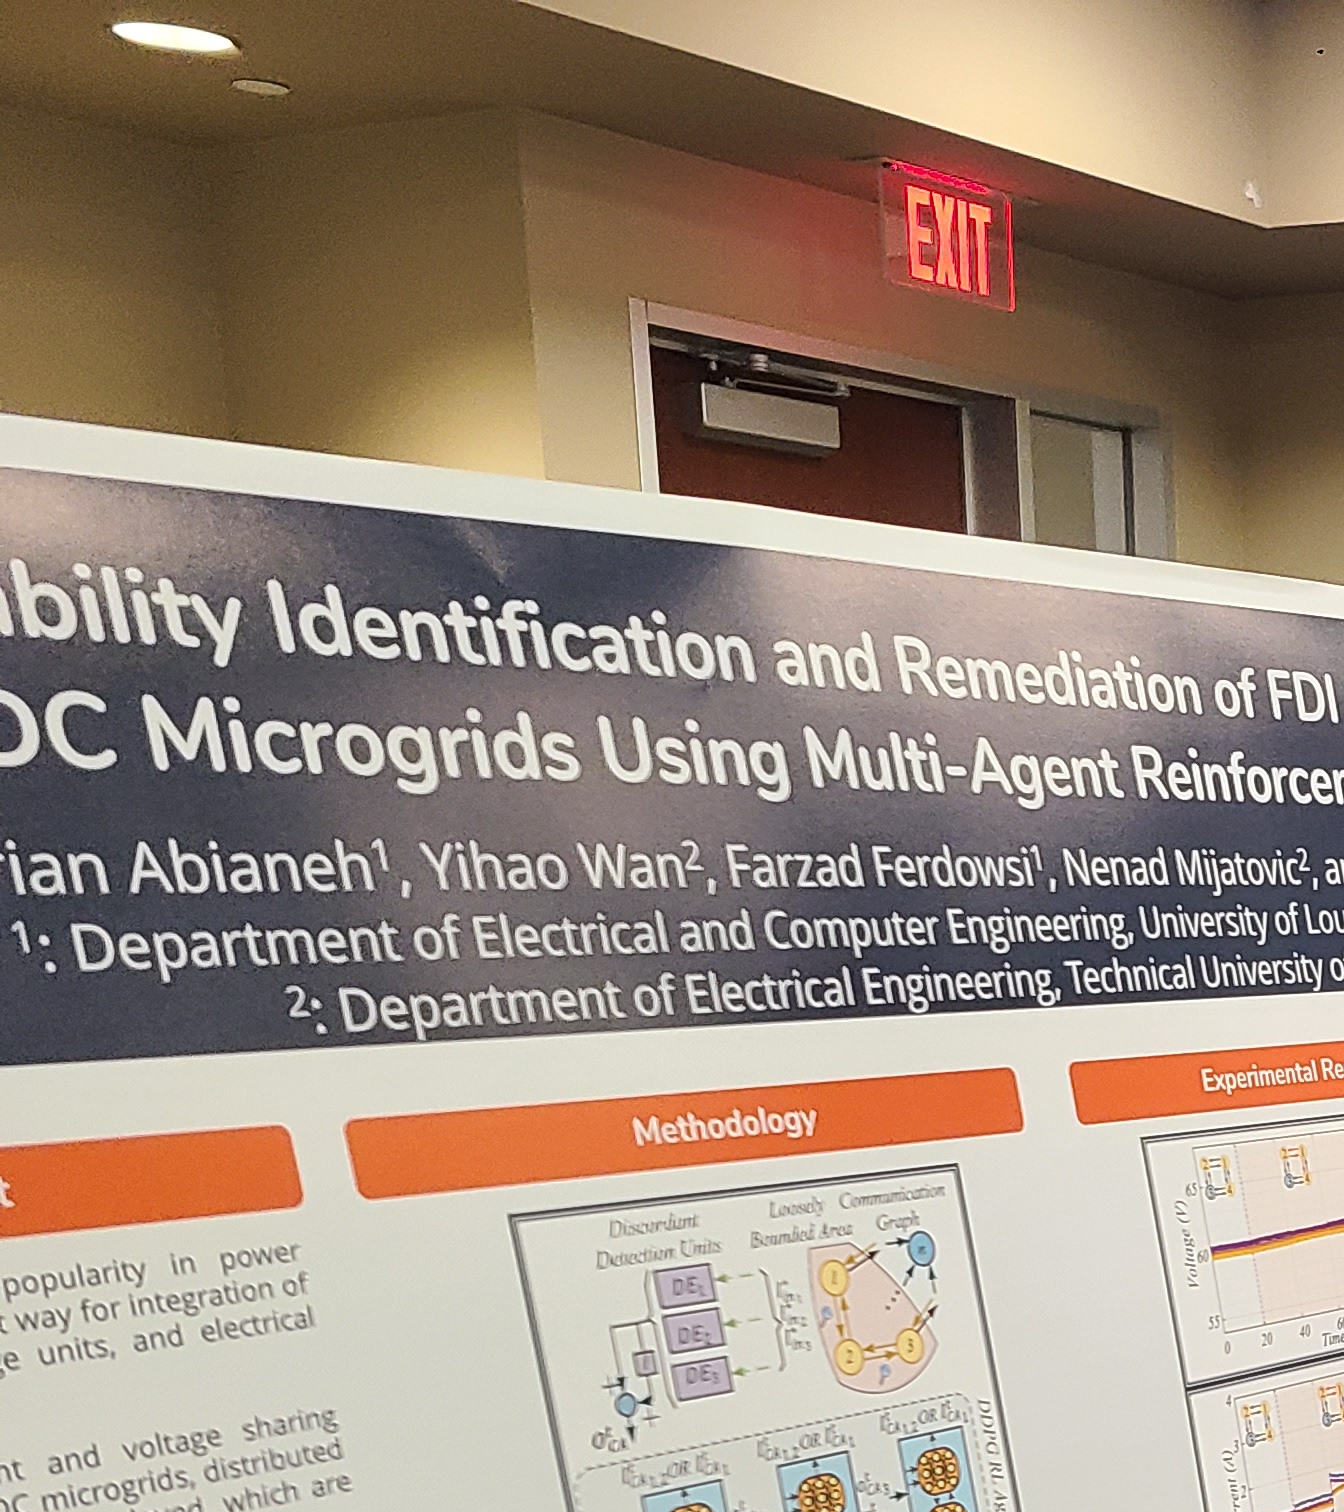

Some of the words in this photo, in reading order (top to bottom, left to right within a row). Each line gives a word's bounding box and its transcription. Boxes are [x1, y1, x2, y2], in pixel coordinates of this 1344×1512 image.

[904, 183, 992, 297] EXIT
[0, 558, 240, 667] bility
[266, 578, 757, 685] Identification
[773, 629, 882, 692] and
[896, 635, 1202, 717] Remediation
[1215, 668, 1257, 717] of
[1267, 669, 1341, 726] FDI
[141, 692, 582, 794] Microgrids
[598, 715, 793, 802] Using
[807, 725, 1123, 810] Multi-Agent
[419, 839, 568, 892] Yihao
[724, 842, 866, 889] Farzad
[1063, 847, 1169, 886] Nenad
[69, 917, 404, 984] Department
[413, 912, 463, 961] of
[474, 908, 669, 961] Electrical
[678, 908, 757, 955] and
[763, 908, 940, 962] Computer
[948, 904, 1136, 954] Engineering,
[1139, 901, 1269, 949] University
[1273, 901, 1300, 938] of
[339, 977, 624, 1040] Department
[633, 973, 676, 1020] of
[684, 968, 855, 1017] Electrical
[861, 964, 1064, 1014] Engineering,
[1065, 953, 1196, 997] Technical
[1199, 949, 1324, 994] University
[1201, 1065, 1317, 1095] Experimental
[632, 1108, 817, 1147] Methodology
[3, 1258, 147, 1300] popularity
[171, 1252, 196, 1276] in
[220, 1243, 302, 1272] power
[15, 1302, 72, 1334] way
[81, 1296, 120, 1324] for
[129, 1280, 273, 1316] integration
[282, 1272, 310, 1296] of
[38, 1335, 117, 1367] units,
[133, 1327, 184, 1353] and
[201, 1307, 316, 1342] electrical
[48, 1444, 102, 1476] and
[121, 1426, 222, 1464] voltage
[242, 1405, 339, 1442] sharing
[203, 1438, 345, 1484] distributed
[311, 1472, 353, 1498] are
